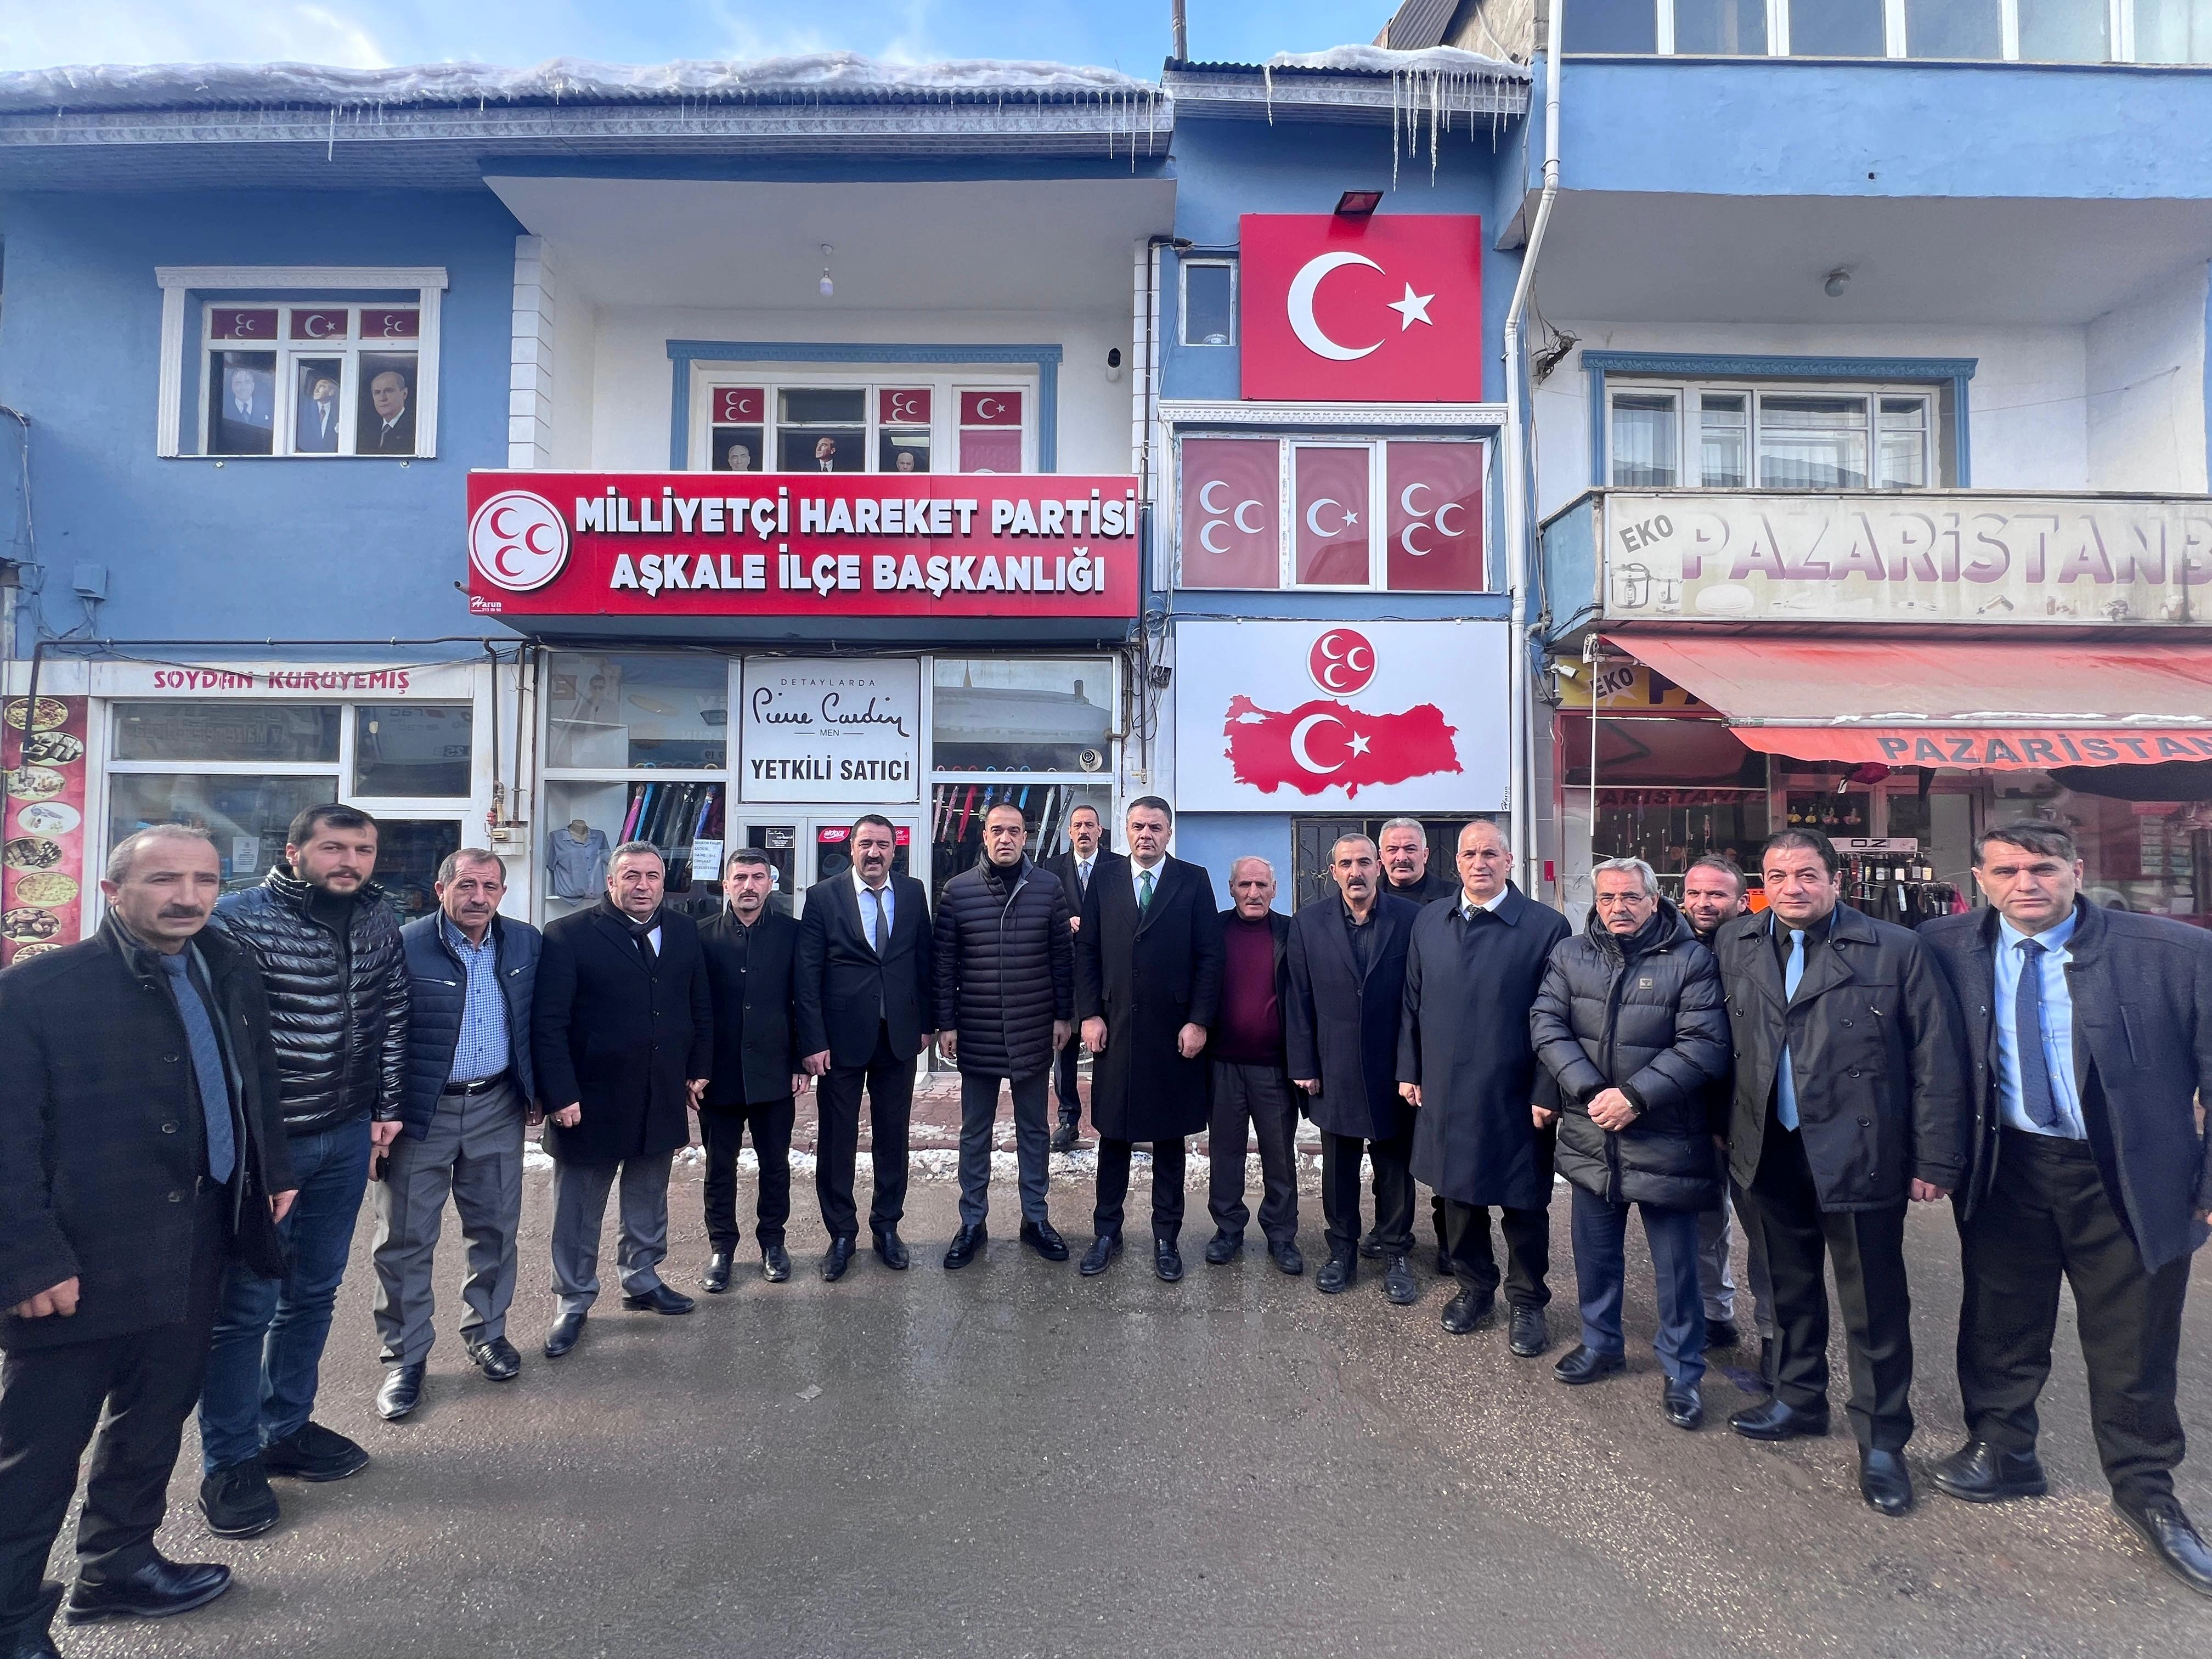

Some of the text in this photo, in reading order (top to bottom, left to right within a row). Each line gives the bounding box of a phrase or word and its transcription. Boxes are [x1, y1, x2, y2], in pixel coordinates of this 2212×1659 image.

[575, 486, 1136, 540] MİLLİYETÇİ HAREKET PARTİSİ
[1619, 514, 1674, 553] EKO
[610, 543, 1104, 598] AŞKALE İLÇE BAŞKANLIĞI
[470, 596, 502, 607] Harun
[154, 670, 253, 690] SOYDAN
[1590, 667, 1634, 699] EKO
[753, 687, 814, 724] Pierre
[821, 692, 910, 738] Cardin
[751, 754, 910, 781] YETKİLİ SATICI
